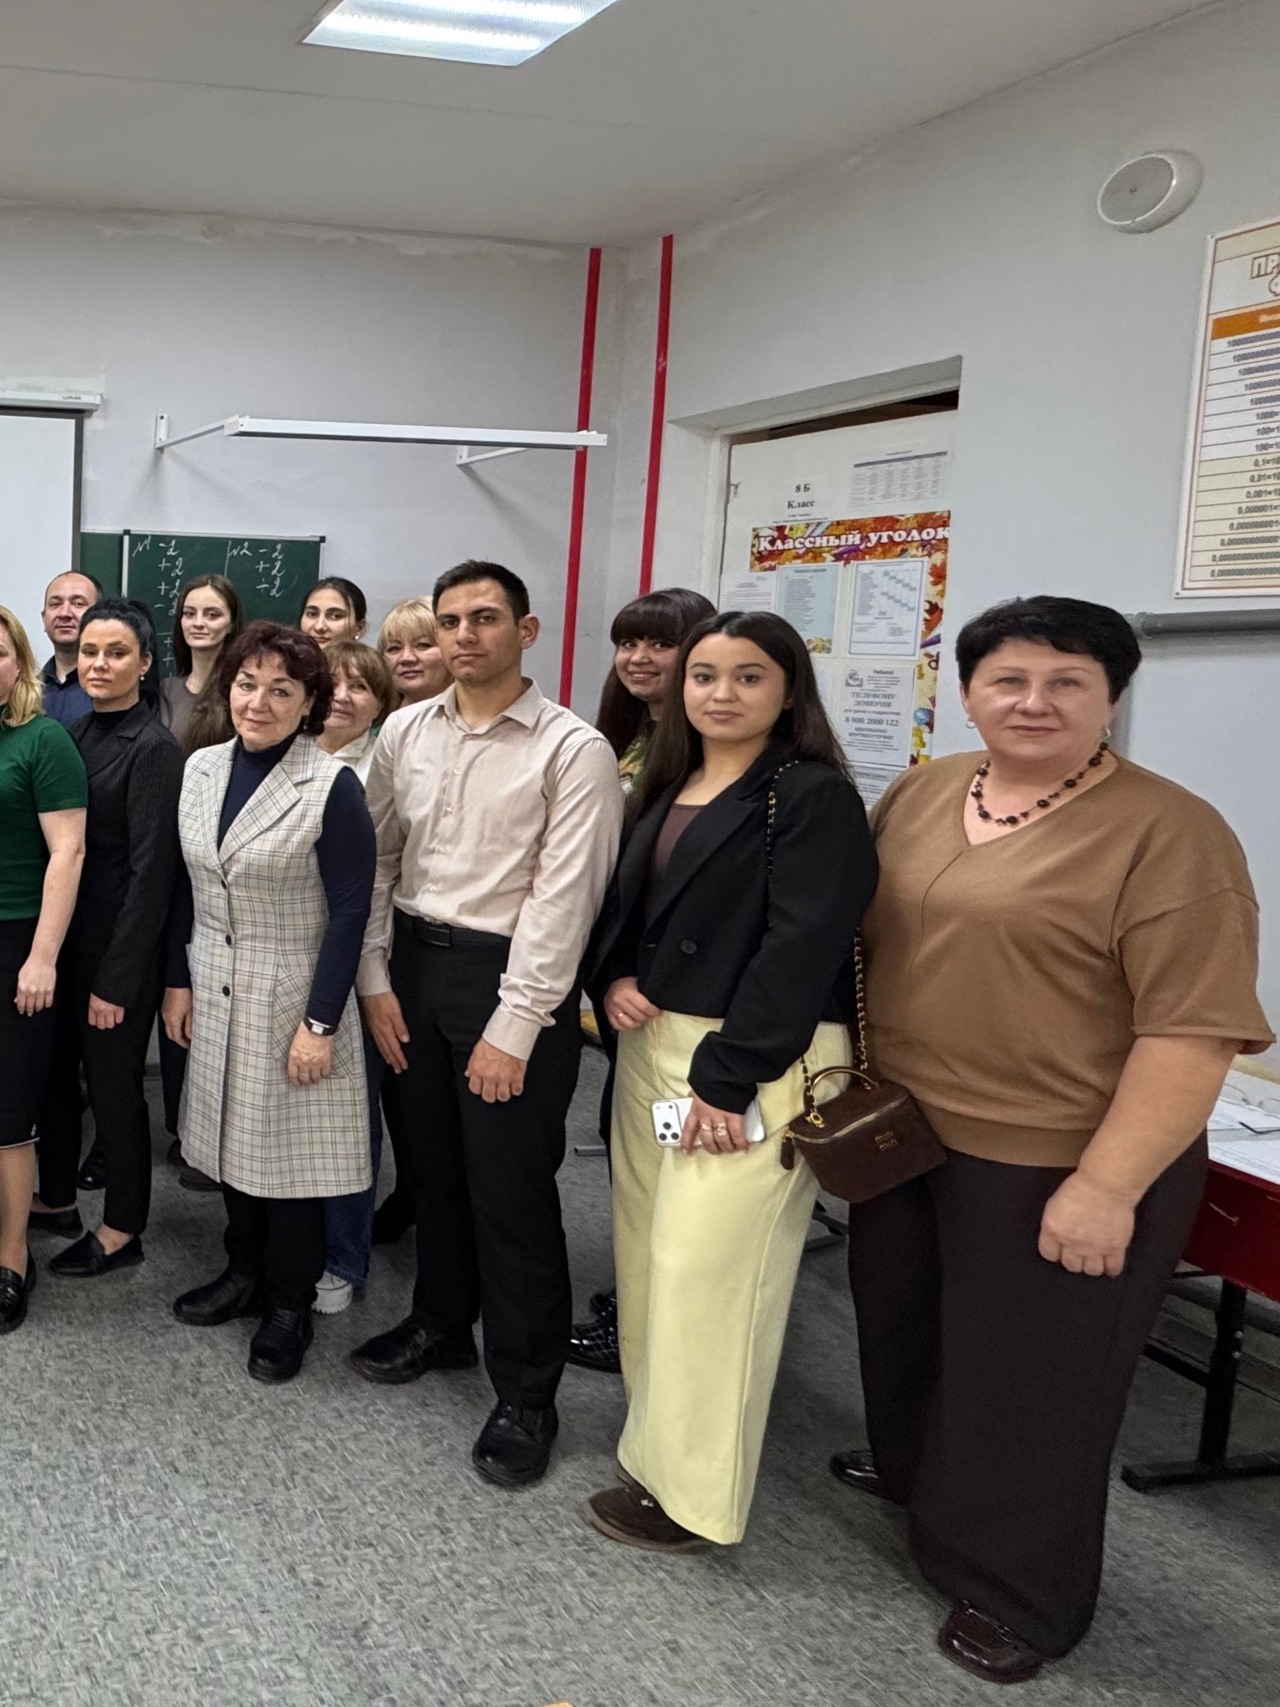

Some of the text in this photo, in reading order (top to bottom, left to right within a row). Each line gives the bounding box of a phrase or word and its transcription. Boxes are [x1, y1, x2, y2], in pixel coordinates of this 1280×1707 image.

[795, 483, 811, 493] 8 Б
[787, 500, 815, 509] Класс
[758, 526, 950, 551] Классный уголок
[851, 691, 896, 700] ТЕЛЕФОНУ
